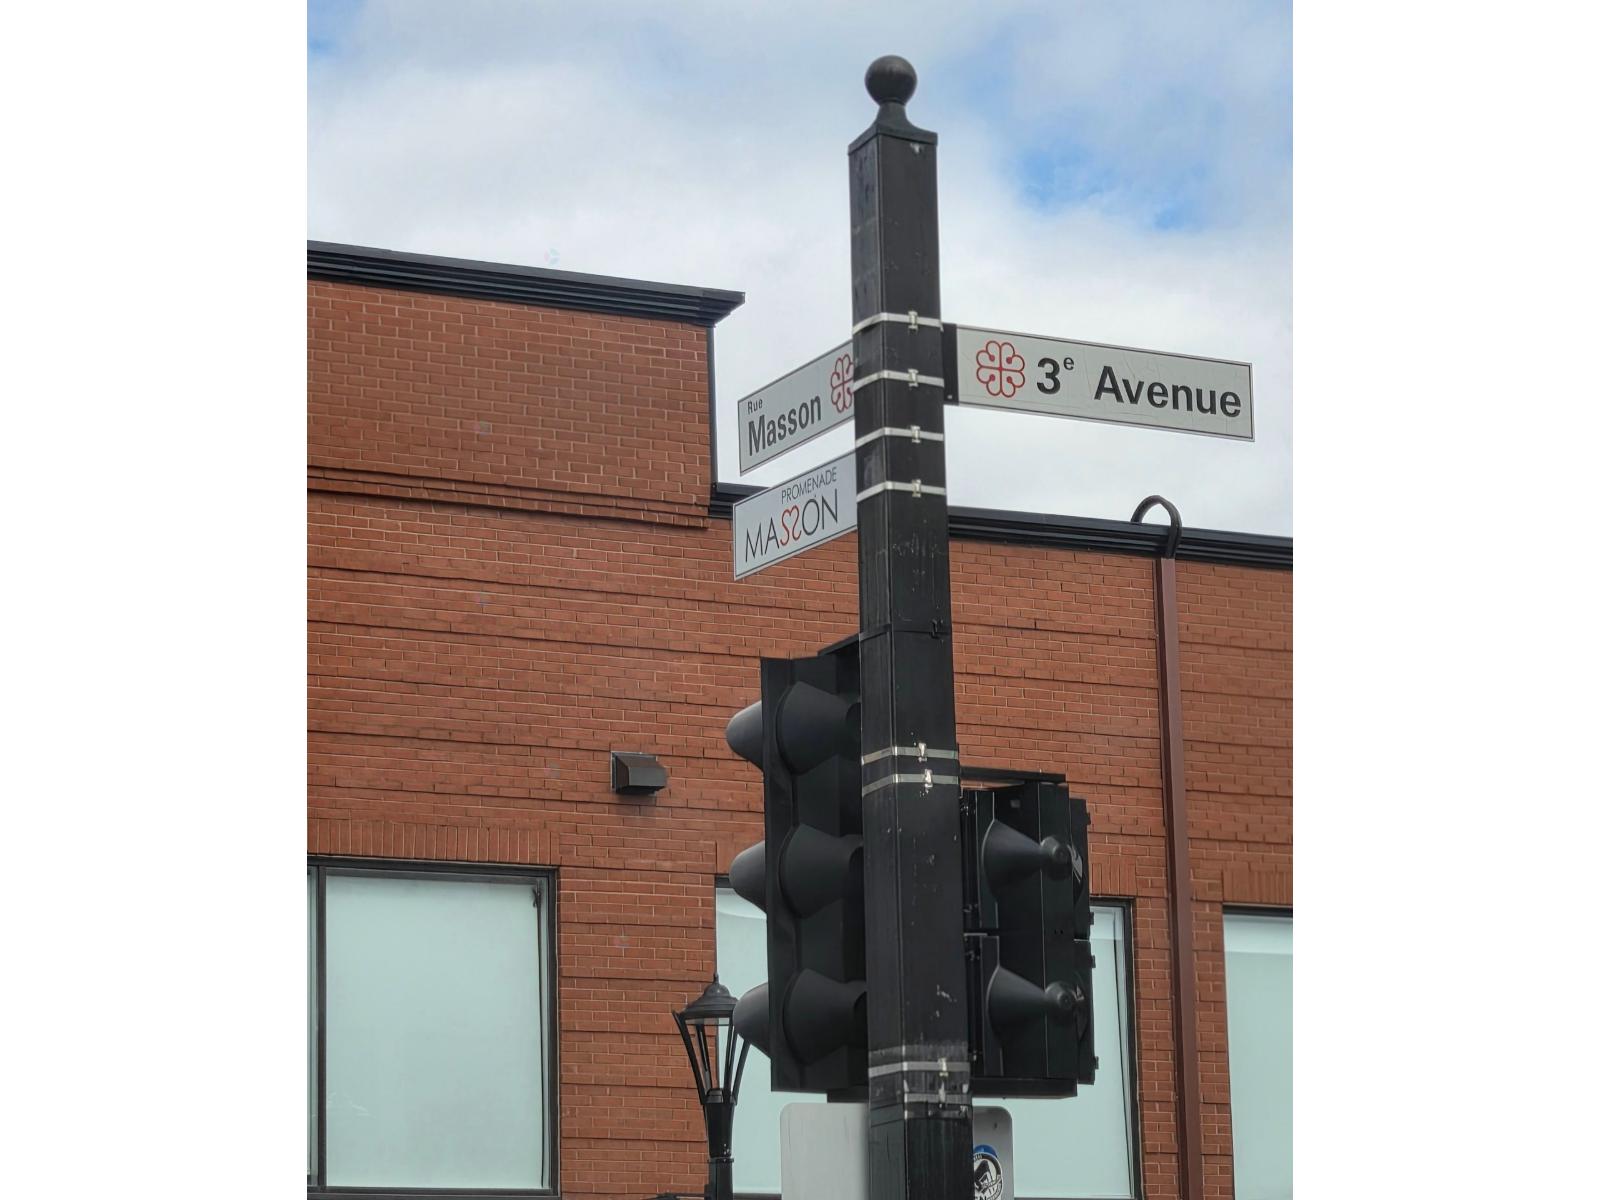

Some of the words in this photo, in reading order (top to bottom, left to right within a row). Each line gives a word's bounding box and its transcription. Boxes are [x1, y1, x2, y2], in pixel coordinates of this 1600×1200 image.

[747, 398, 763, 415] Rue
[1094, 365, 1242, 418] Avenue
[748, 395, 822, 457] Masson
[781, 466, 838, 505] PROMENADE
[745, 488, 839, 563] MASSON
